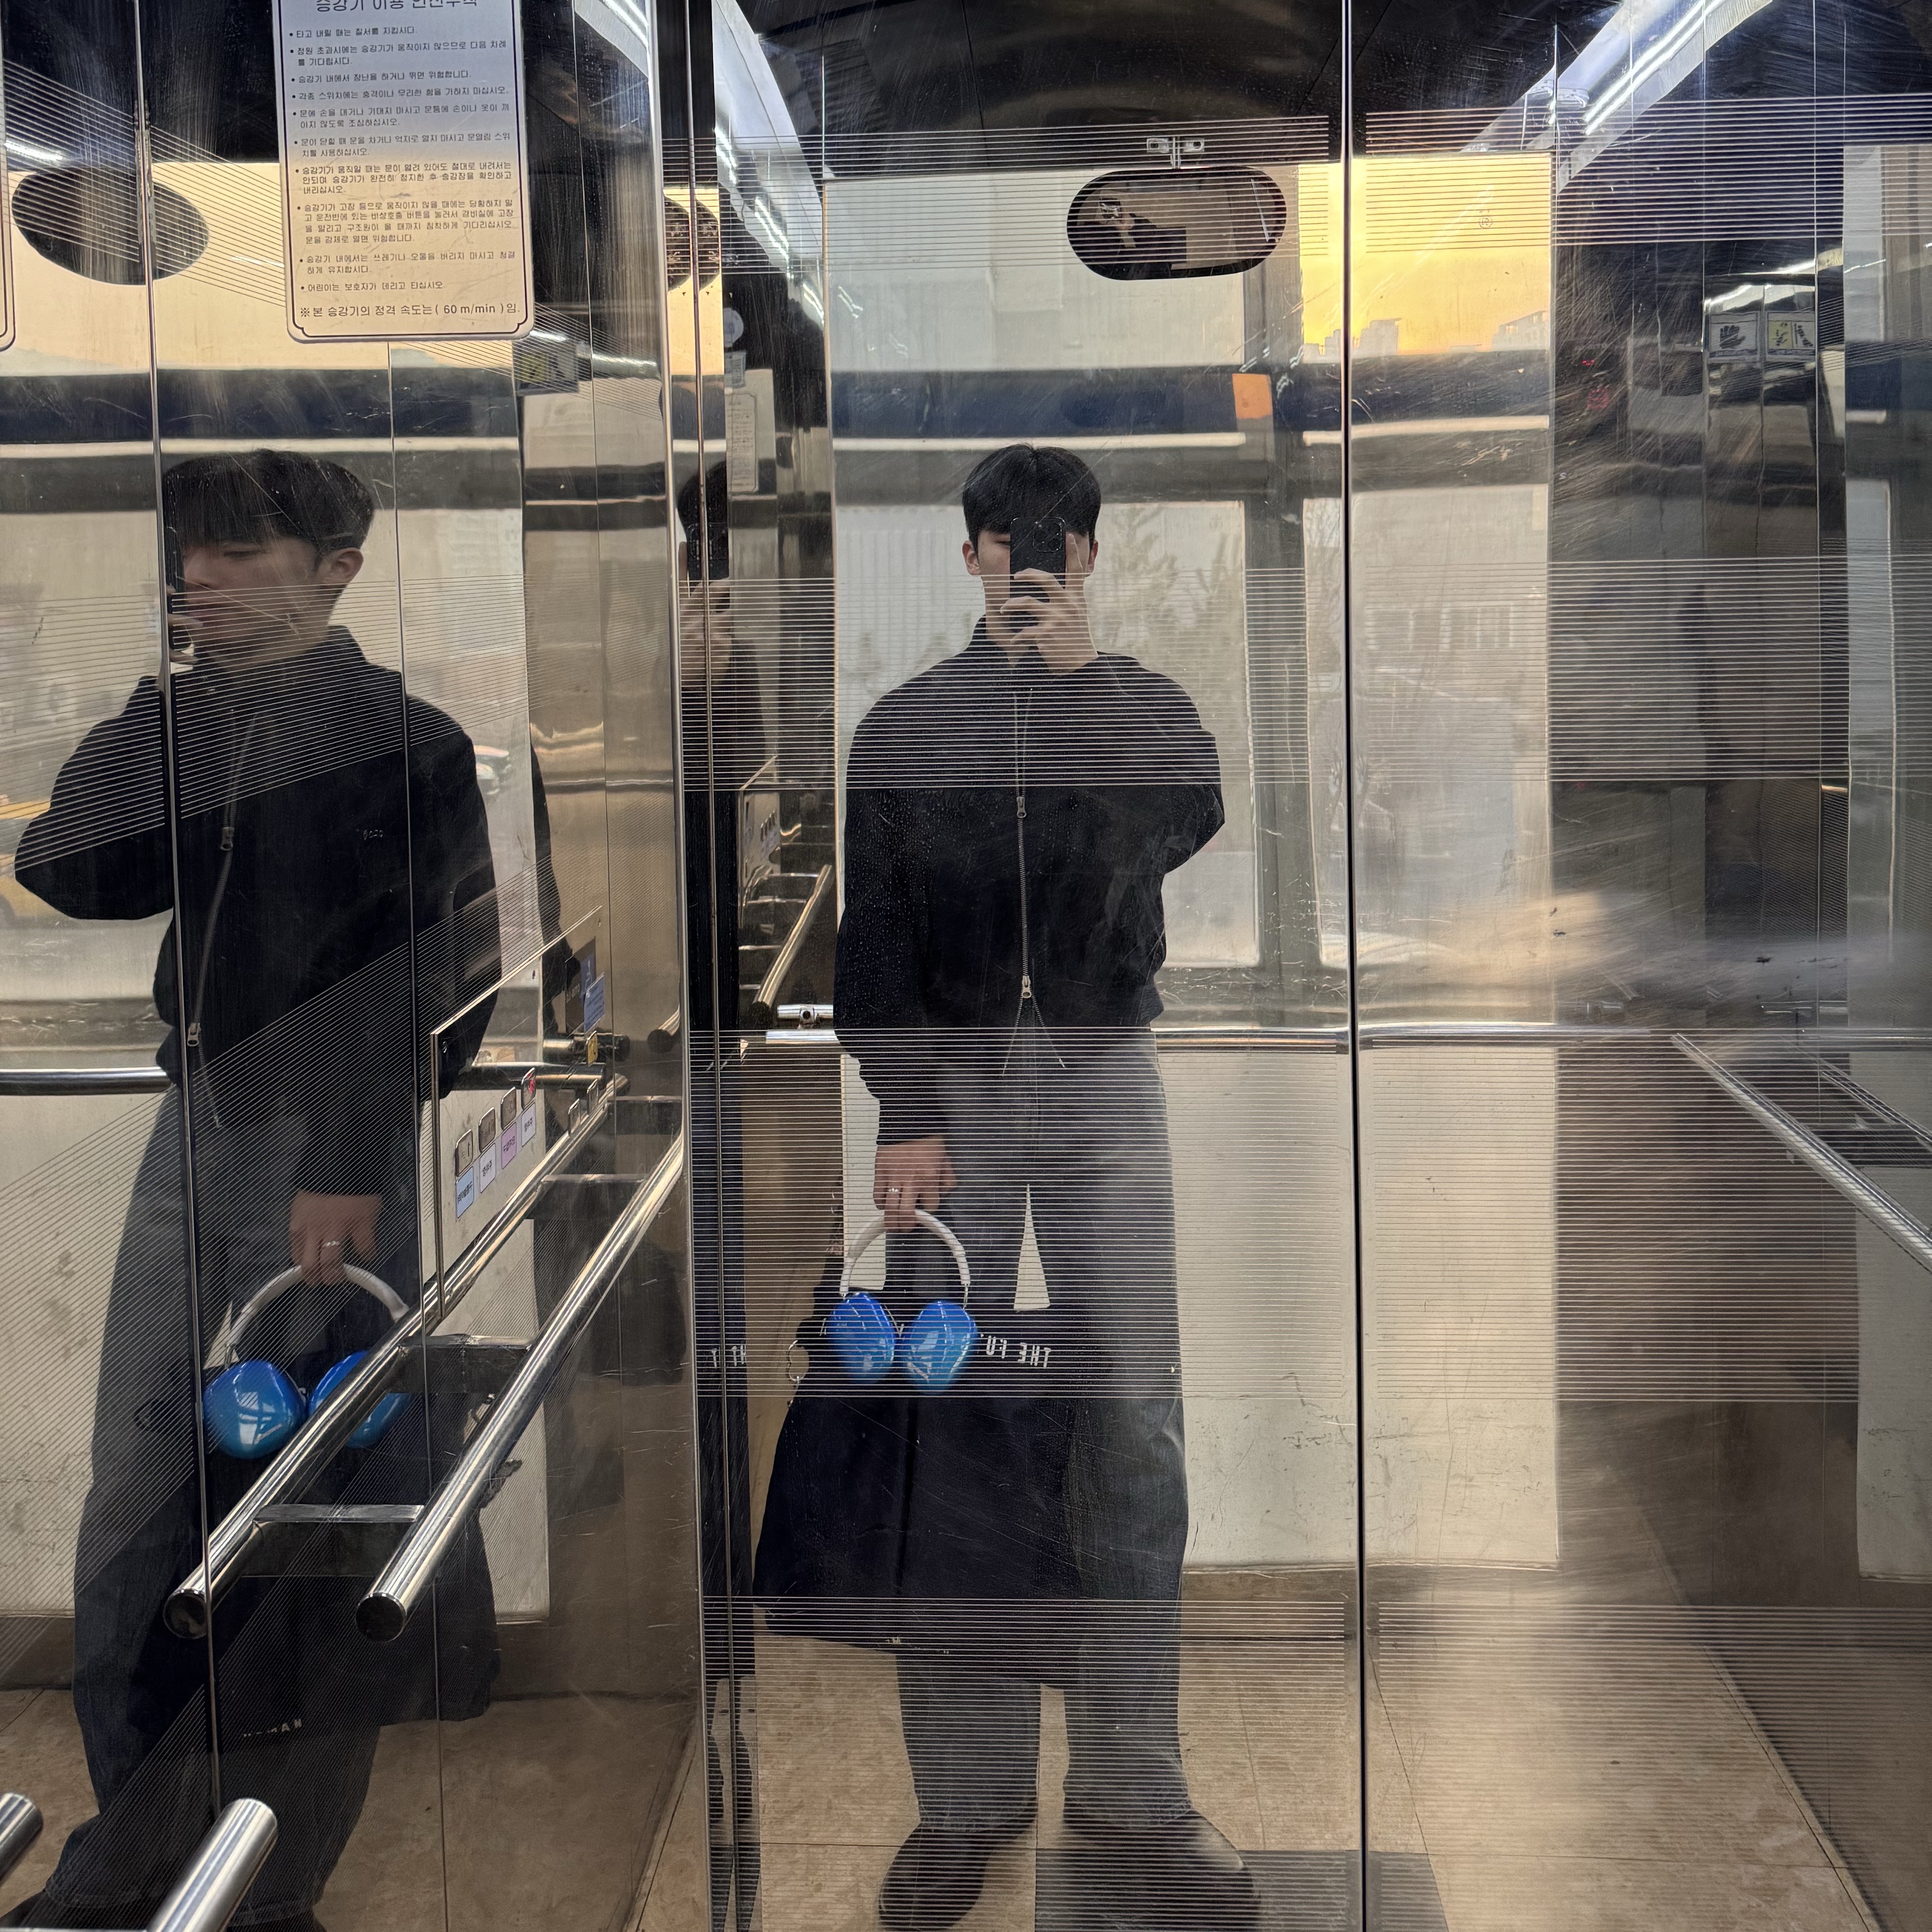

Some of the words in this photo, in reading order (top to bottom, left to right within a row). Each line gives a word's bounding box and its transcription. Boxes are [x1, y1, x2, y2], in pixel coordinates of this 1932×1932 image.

[296, 30, 312, 38] 타고
[317, 29, 332, 37] 내릴
[336, 28, 351, 37] 때는
[383, 26, 418, 35] 지킵시다.
[298, 47, 313, 55] 정원
[317, 46, 358, 55] 초과시에는
[362, 44, 394, 53] 승강기가
[398, 43, 430, 52] 움직이지
[434, 41, 466, 51] 않으므로
[470, 41, 487, 49] 다음
[490, 40, 507, 49] 차례
[309, 57, 353, 66] 기다립시다.
[299, 75, 322, 83] 승강기
[326, 74, 350, 83] 내에서
[354, 73, 378, 82] 장난을
[381, 72, 405, 81] 하거나
[409, 71, 424, 80] 뛰면
[299, 92, 315, 101] 각종
[319, 91, 359, 100] 스위치에는
[363, 89, 394, 98] 충격이나
[398, 88, 422, 97] 무리한
[445, 87, 470, 96] 가하지
[473, 86, 509, 95] 마십시오.
[300, 109, 316, 118] 문에
[320, 109, 336, 117] 손을
[340, 107, 364, 116] 대거나
[368, 106, 392, 115] 기대지
[396, 105, 420, 115] 마시고
[453, 104, 477, 113] 손이나
[481, 104, 498, 112] 옷이
[301, 120, 316, 129] 이지
[349, 118, 401, 128] 조심하십시오.
[301, 138, 317, 147] 문이
[339, 137, 346, 145] 때
[350, 136, 365, 145] 문을
[369, 135, 392, 144] 차거나
[395, 134, 419, 143] 억지로
[422, 134, 438, 143] 열지
[441, 133, 465, 142] 마시고
[468, 133, 491, 142] 문열림
[495, 132, 511, 141] 스위
[303, 166, 334, 175] 승강기가
[338, 165, 362, 174] 움직일
[366, 165, 381, 173] 때는
[385, 164, 401, 173] 문이
[405, 163, 420, 172] 열려
[424, 162, 448, 171] 있어도
[452, 162, 475, 171] 절대로
[480, 161, 512, 170] 내려서는
[303, 176, 327, 185] 안되며
[333, 175, 365, 184] 승강기가
[370, 174, 395, 183] 완전히
[401, 173, 425, 182] 정지한
[442, 172, 475, 180] 승강장을
[480, 171, 512, 180] 확인하고
[304, 185, 346, 194] 내리십시오.
[304, 203, 336, 212] 승강기가
[340, 203, 355, 211] 고장
[360, 202, 383, 211] 등으로
[387, 201, 419, 210] 움직이지
[422, 200, 438, 209] 않을
[442, 200, 466, 209] 때에는
[304, 214, 313, 222] 고
[316, 212, 348, 221] 운전반에
[352, 212, 368, 221] 있는
[407, 211, 430, 219] 버튼을
[462, 209, 494, 218] 경비실에
[498, 209, 514, 217] 고장
[318, 224, 342, 233] 알리고
[347, 223, 379, 232] 구조원이
[397, 222, 421, 231] 때까지
[426, 221, 458, 230] 침착하게
[306, 236, 321, 244] 문을
[325, 235, 349, 244] 강제로
[353, 235, 369, 243] 열면
[307, 255, 331, 264] 승강기
[336, 254, 369, 263] 내에서는
[373, 253, 406, 262] 쓰레기나
[441, 252, 465, 261] 버리지
[470, 251, 494, 260] 마시고
[500, 250, 516, 260] 청결
[307, 266, 323, 275] 하게
[308, 283, 340, 292] 어린이는
[345, 282, 377, 291] 보호자가
[383, 281, 406, 290] 데리고
[411, 281, 446, 290] 타십시오.
[328, 306, 370, 317] 승강기의
[375, 305, 396, 316] 정격
[461, 303, 496, 315] m/min
